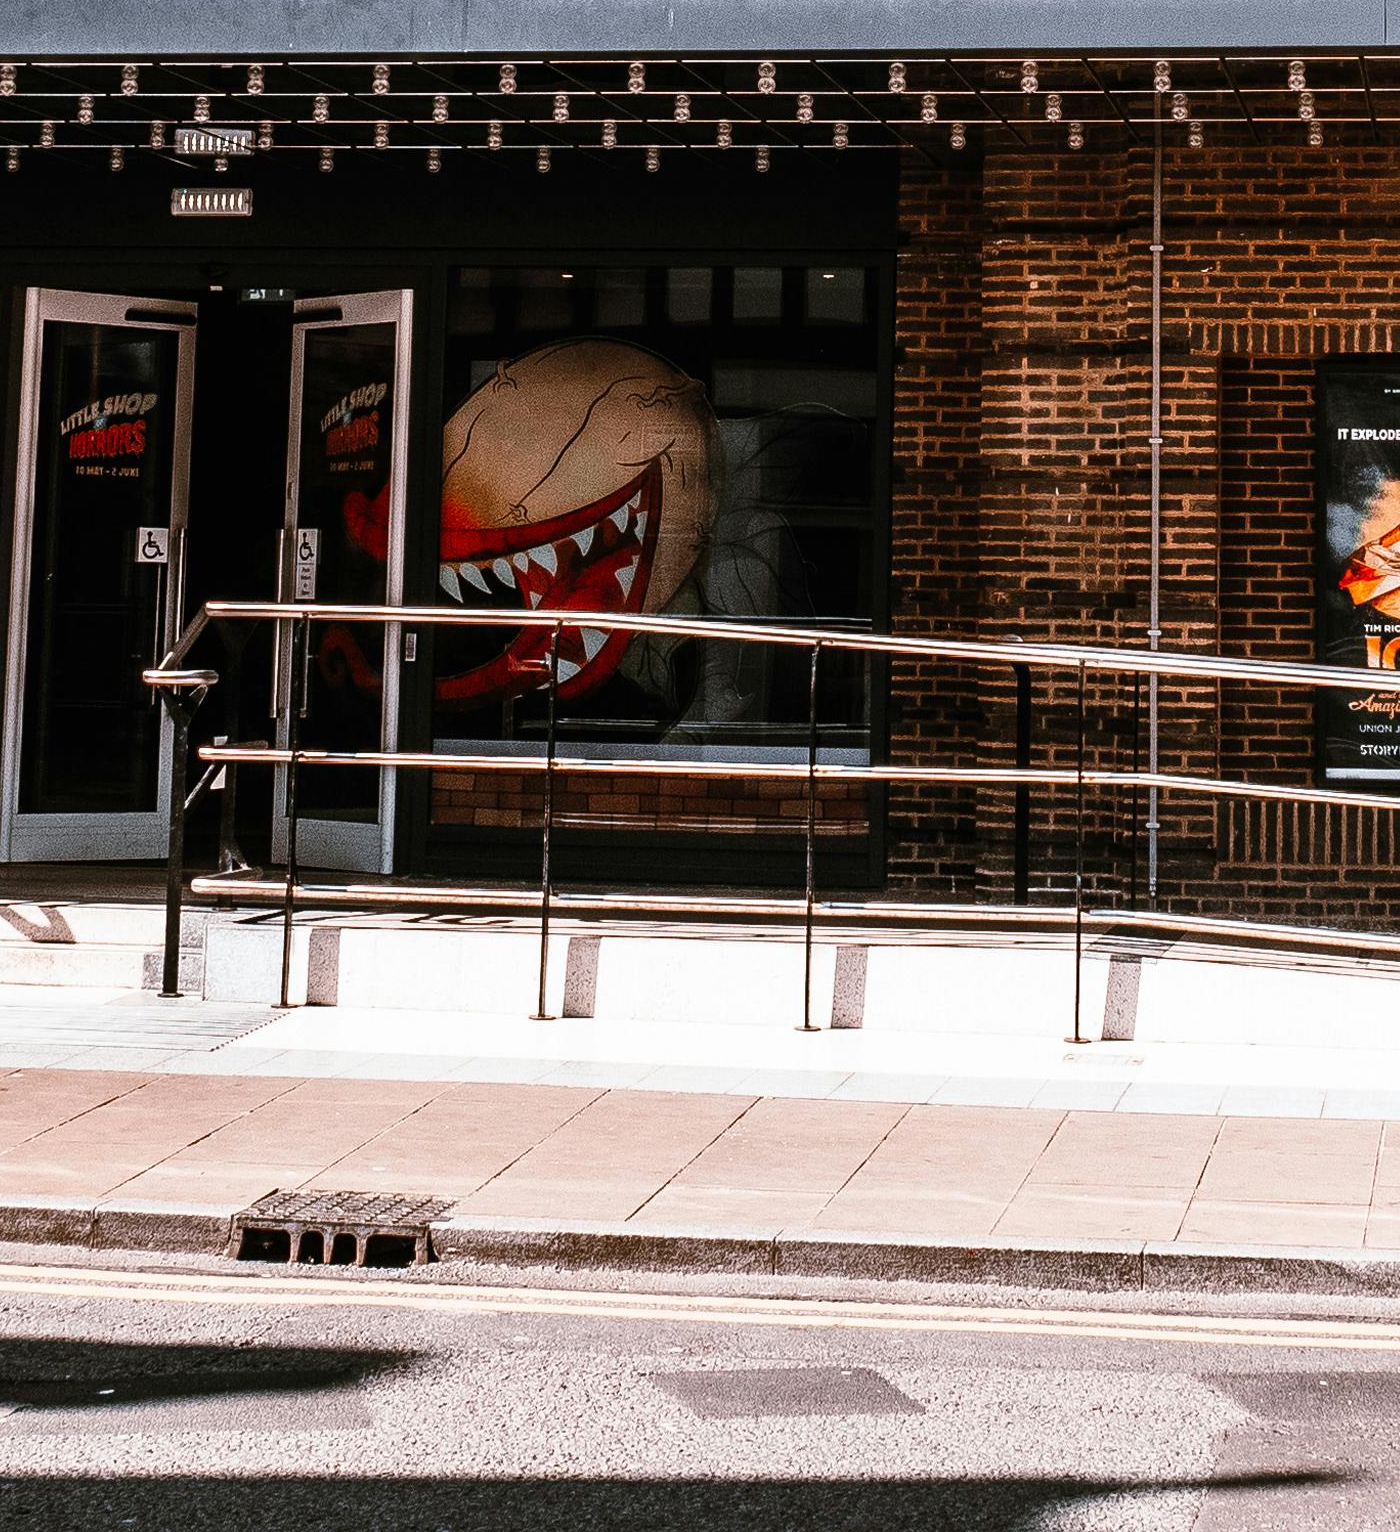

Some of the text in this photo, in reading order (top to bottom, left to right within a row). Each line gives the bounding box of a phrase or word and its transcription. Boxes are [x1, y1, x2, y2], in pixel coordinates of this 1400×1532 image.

[60, 392, 158, 436] LITTLE SHOP
[1337, 428, 1349, 440] IT
[1364, 624, 1382, 633] TIM
[1359, 724, 1392, 733] UNION
